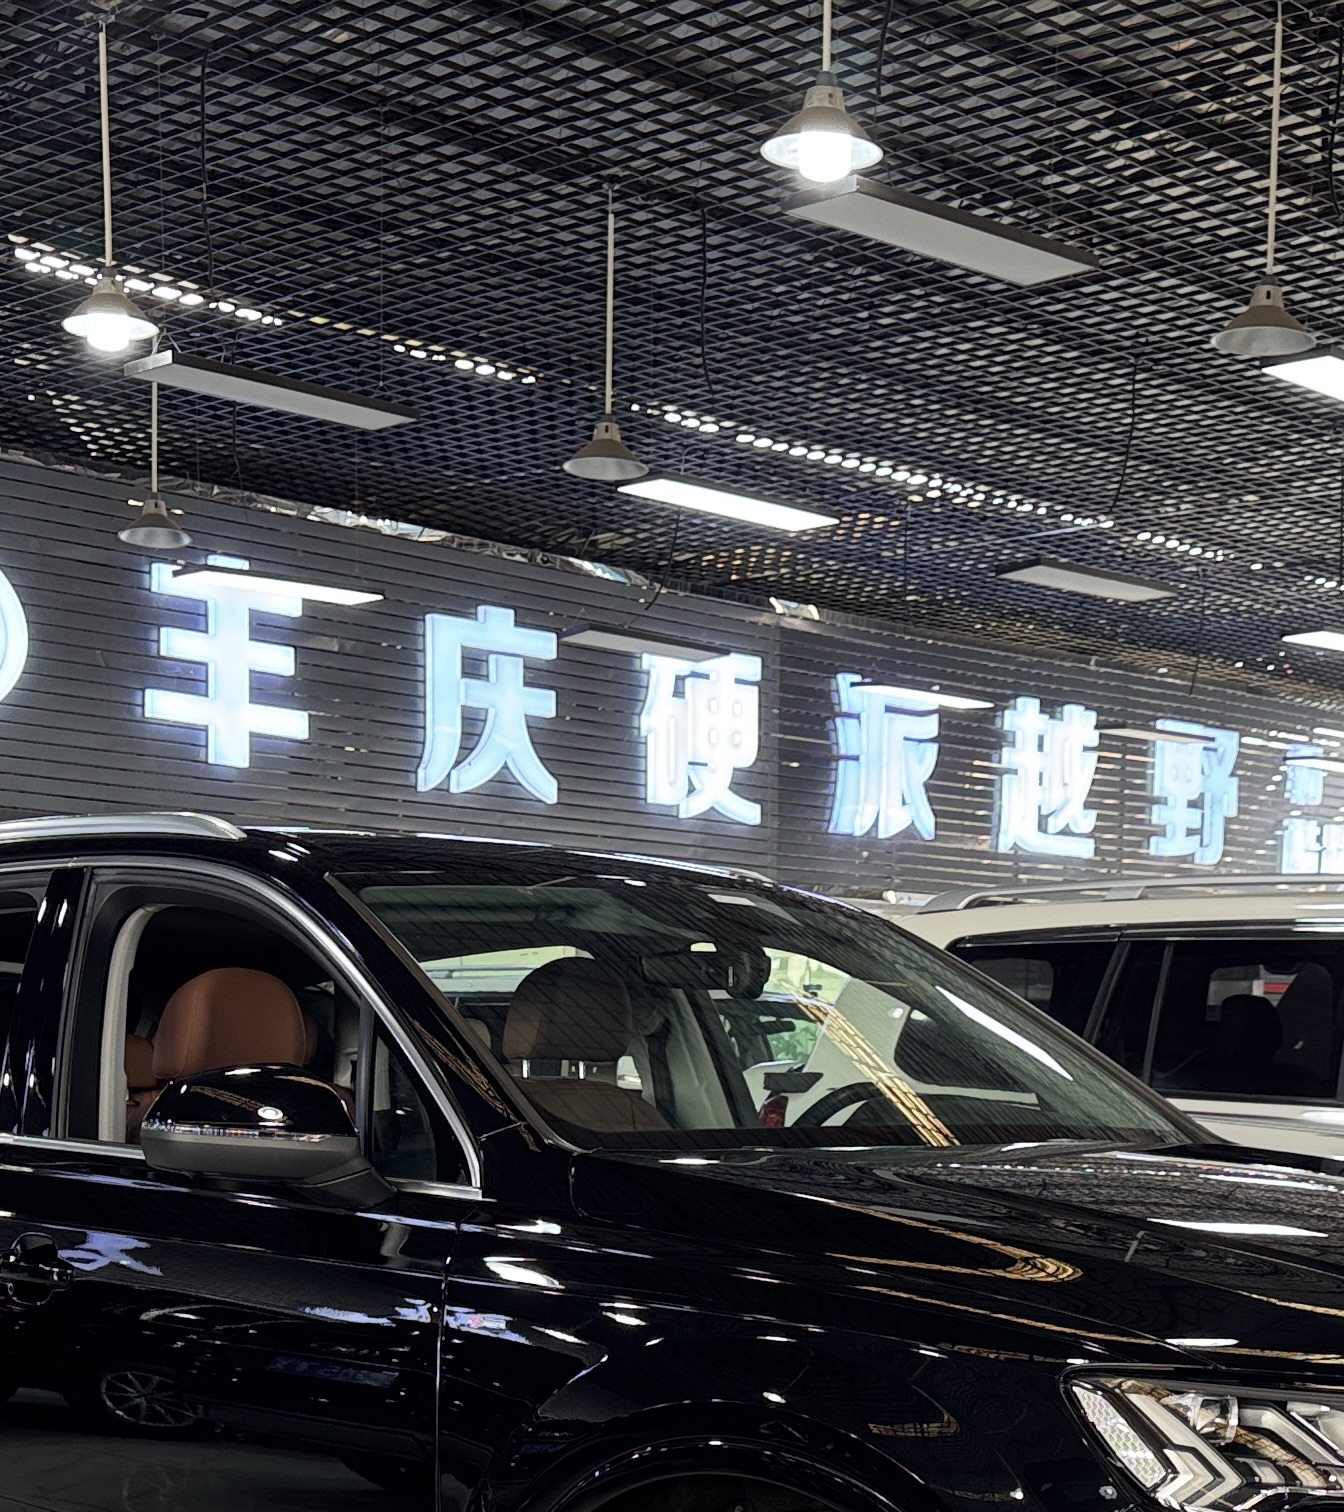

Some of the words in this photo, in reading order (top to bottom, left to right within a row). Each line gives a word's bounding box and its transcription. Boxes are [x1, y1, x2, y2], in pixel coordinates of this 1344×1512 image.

[143, 554, 1240, 865] 丰庆硬派越野
